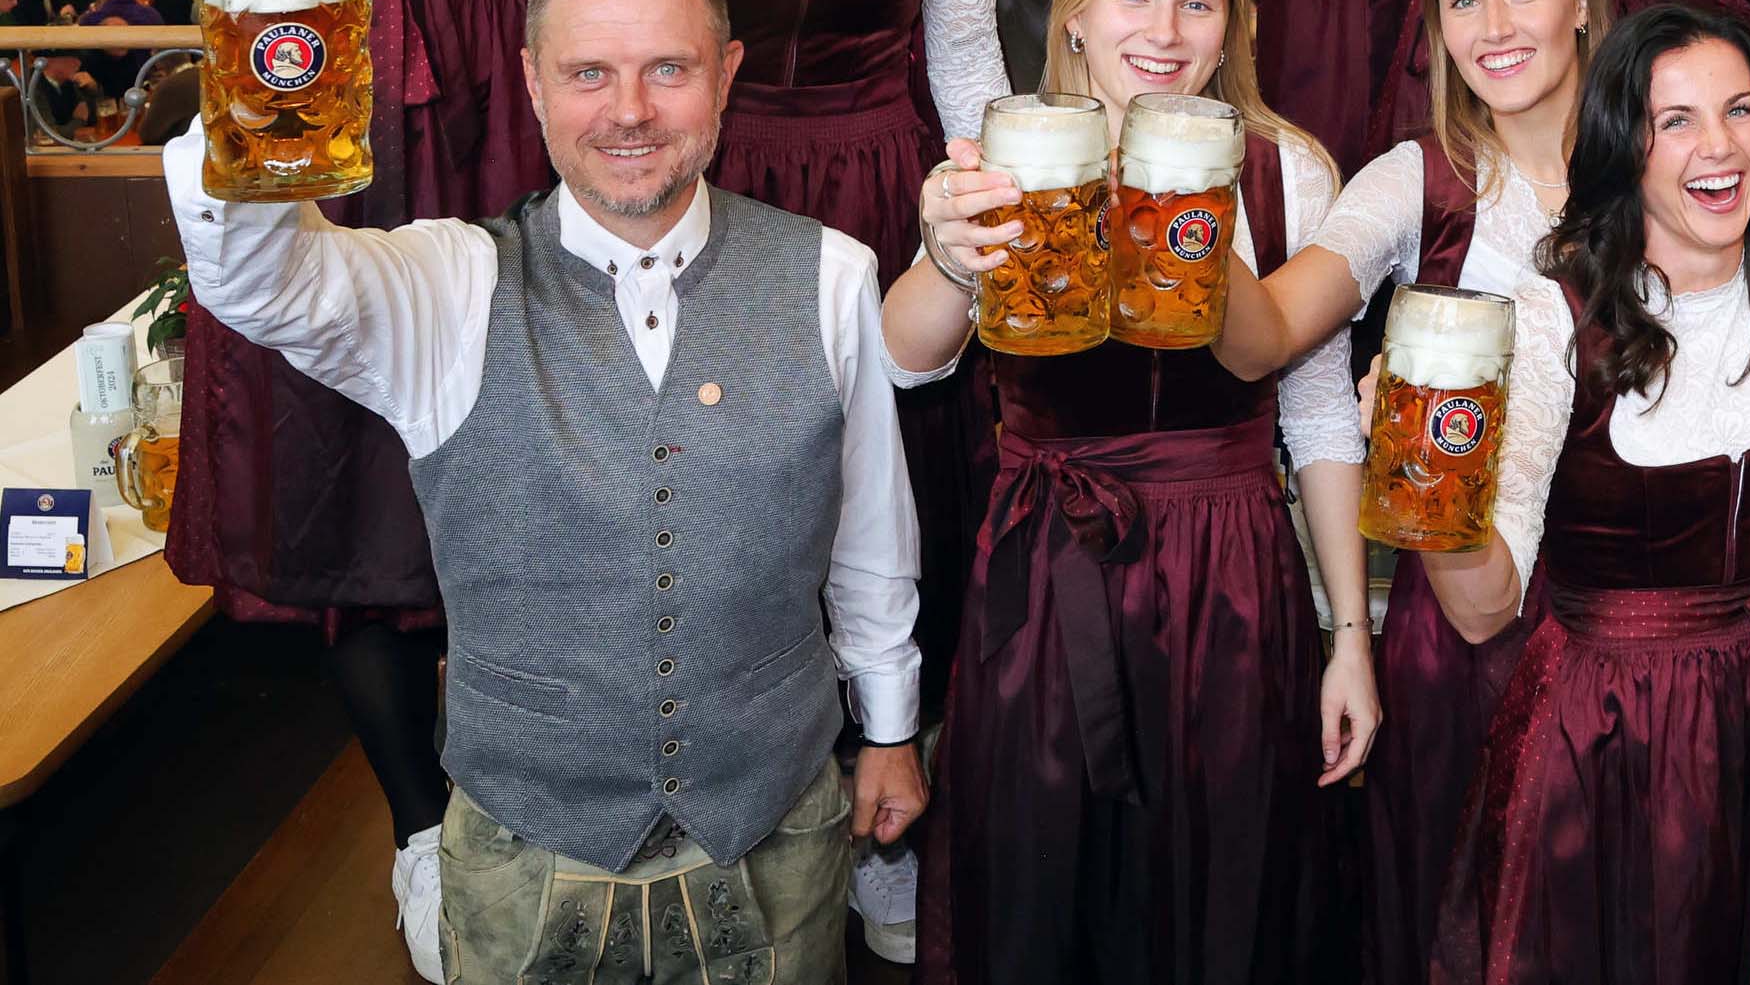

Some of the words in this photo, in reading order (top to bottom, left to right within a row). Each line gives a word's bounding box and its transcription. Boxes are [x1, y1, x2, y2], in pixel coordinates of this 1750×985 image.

[256, 26, 320, 50] PAULANER
[262, 69, 316, 87] MÜNCHEN
[1172, 211, 1217, 229] PAULANER
[94, 356, 108, 409] OKTOBERFEST
[106, 370, 117, 391] 2024
[1436, 400, 1483, 420] PAULANER
[1436, 437, 1477, 453] MÜNCHEN
